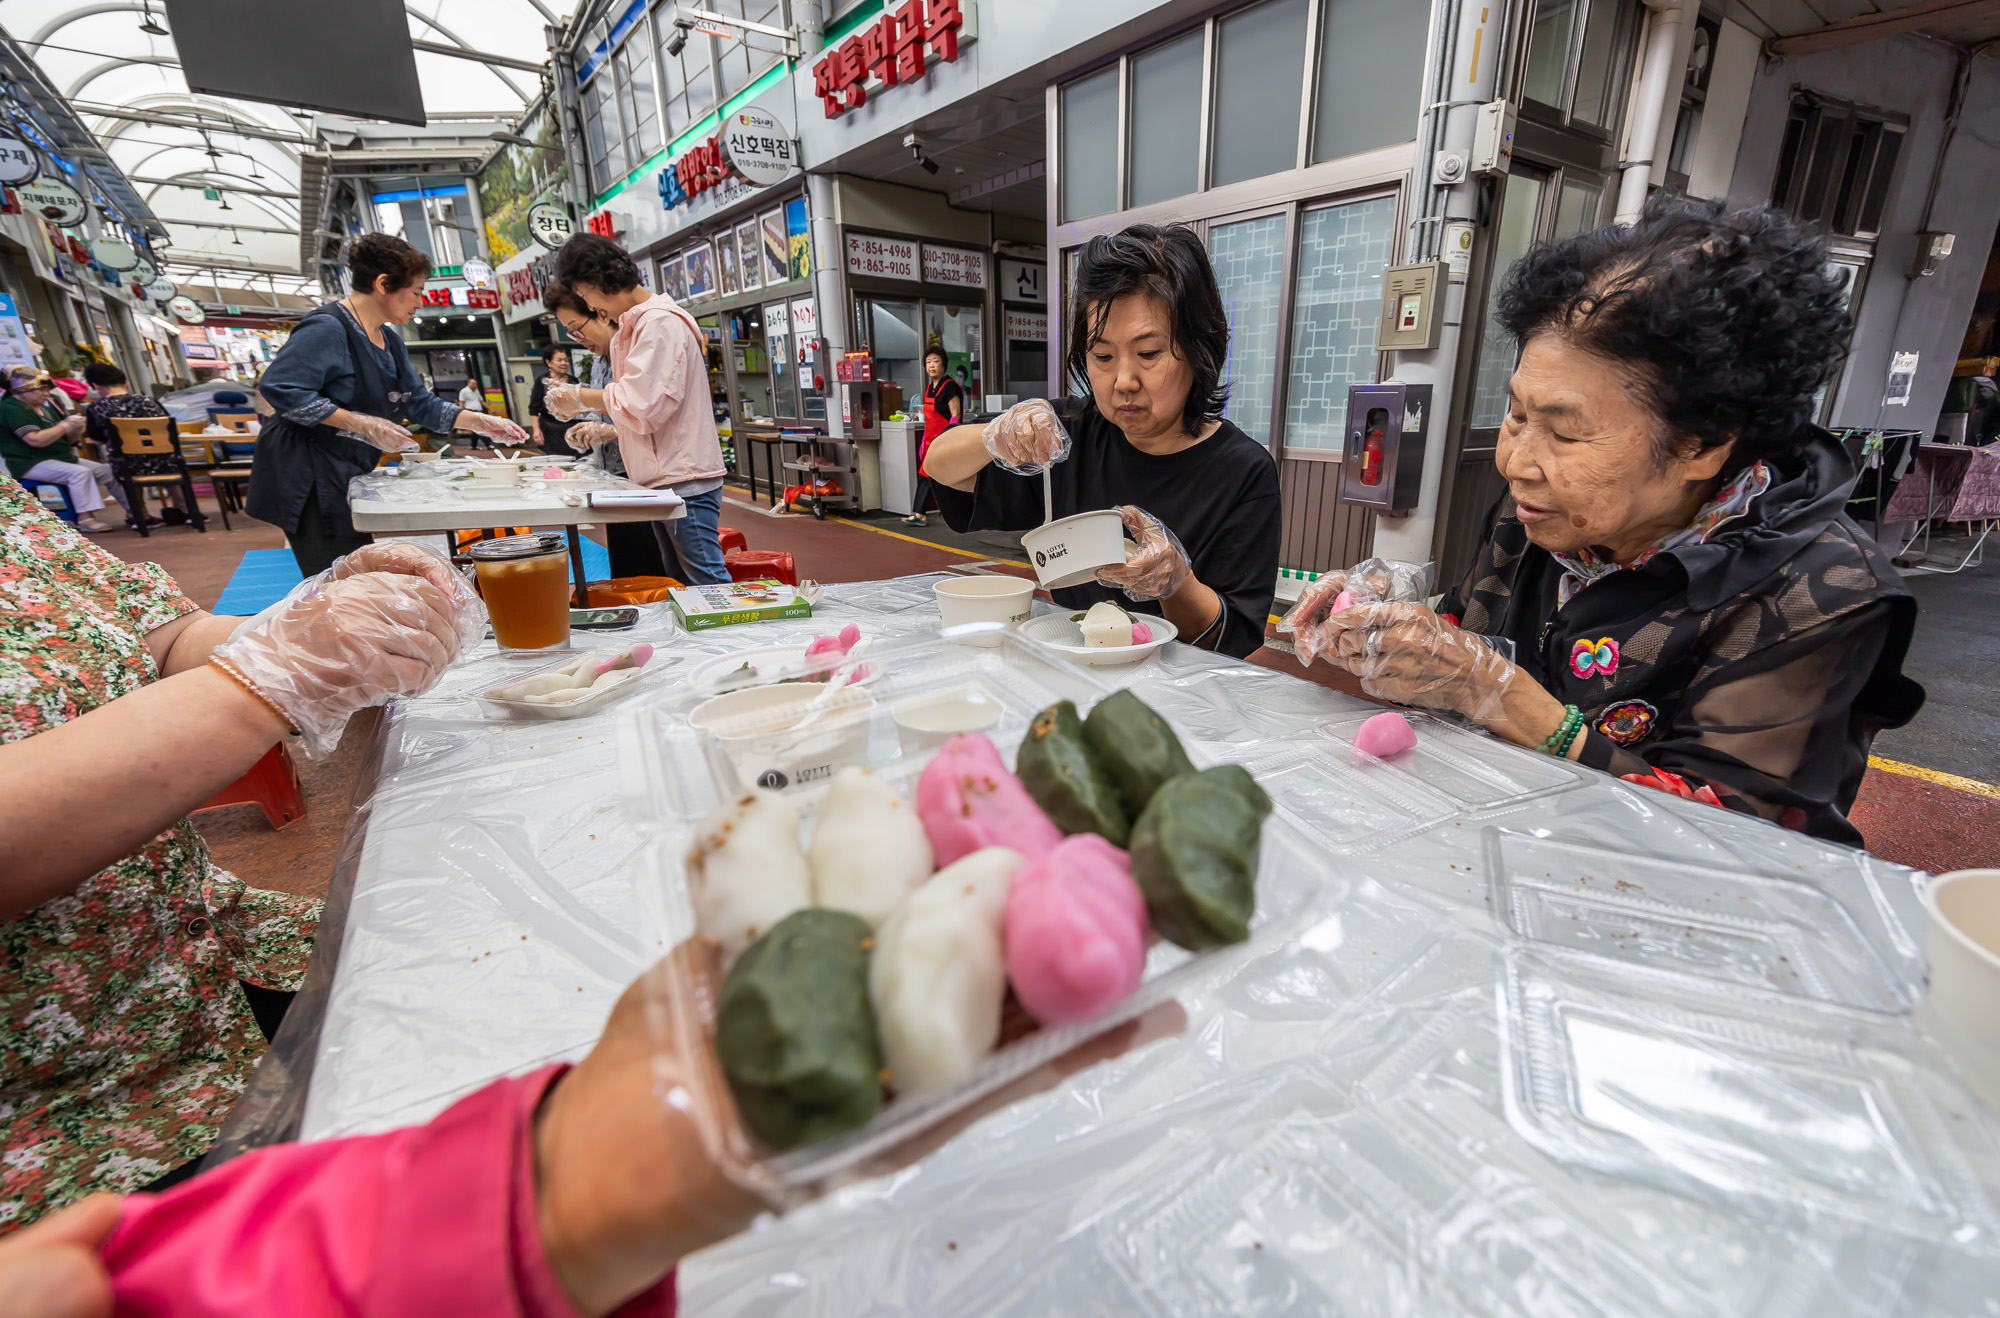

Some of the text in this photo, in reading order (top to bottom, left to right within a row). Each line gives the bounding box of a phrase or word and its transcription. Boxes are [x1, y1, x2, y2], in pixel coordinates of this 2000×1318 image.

[696, 19, 717, 31] CCTV
[730, 133, 790, 160] 신호떡집
[737, 159, 788, 172] 010-3708-9105
[538, 216, 571, 234] 장터
[849, 239, 912, 259] 주:854-4968
[923, 249, 981, 269] 010-3708-9105
[923, 266, 982, 284] 010-5323-9105
[1016, 267, 1038, 299] 신
[1046, 542, 1066, 554] LOTTE
[1049, 548, 1068, 560] Mart
[785, 609, 799, 617] 100
